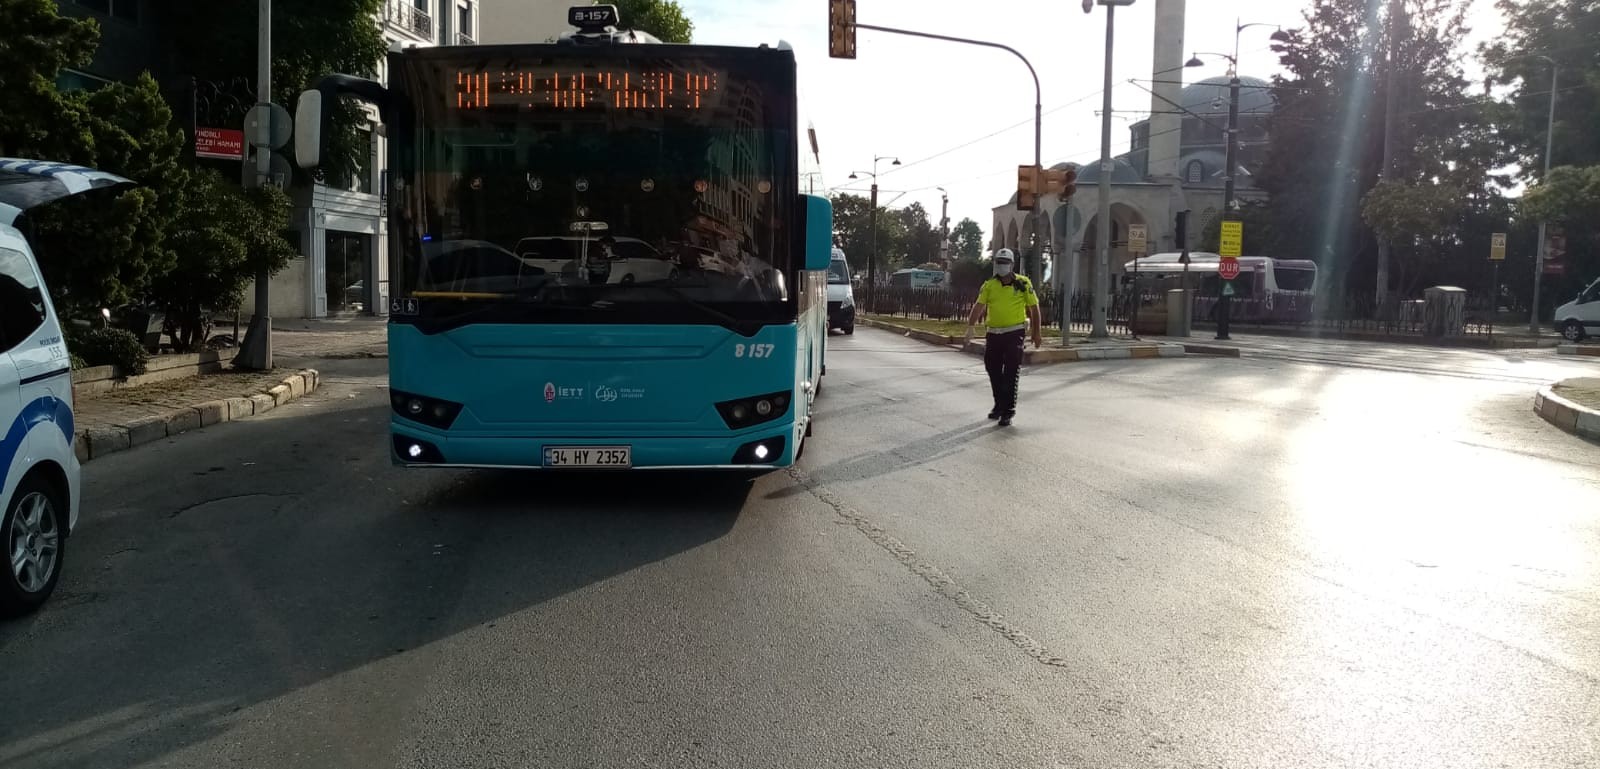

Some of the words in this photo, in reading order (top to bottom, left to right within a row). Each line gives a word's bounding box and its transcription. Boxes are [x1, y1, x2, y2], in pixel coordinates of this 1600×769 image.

[1220, 263, 1238, 273] DUR
[748, 344, 775, 358] 157
[552, 450, 567, 465] 34
[574, 450, 589, 465] HY
[596, 450, 627, 465] 2352
